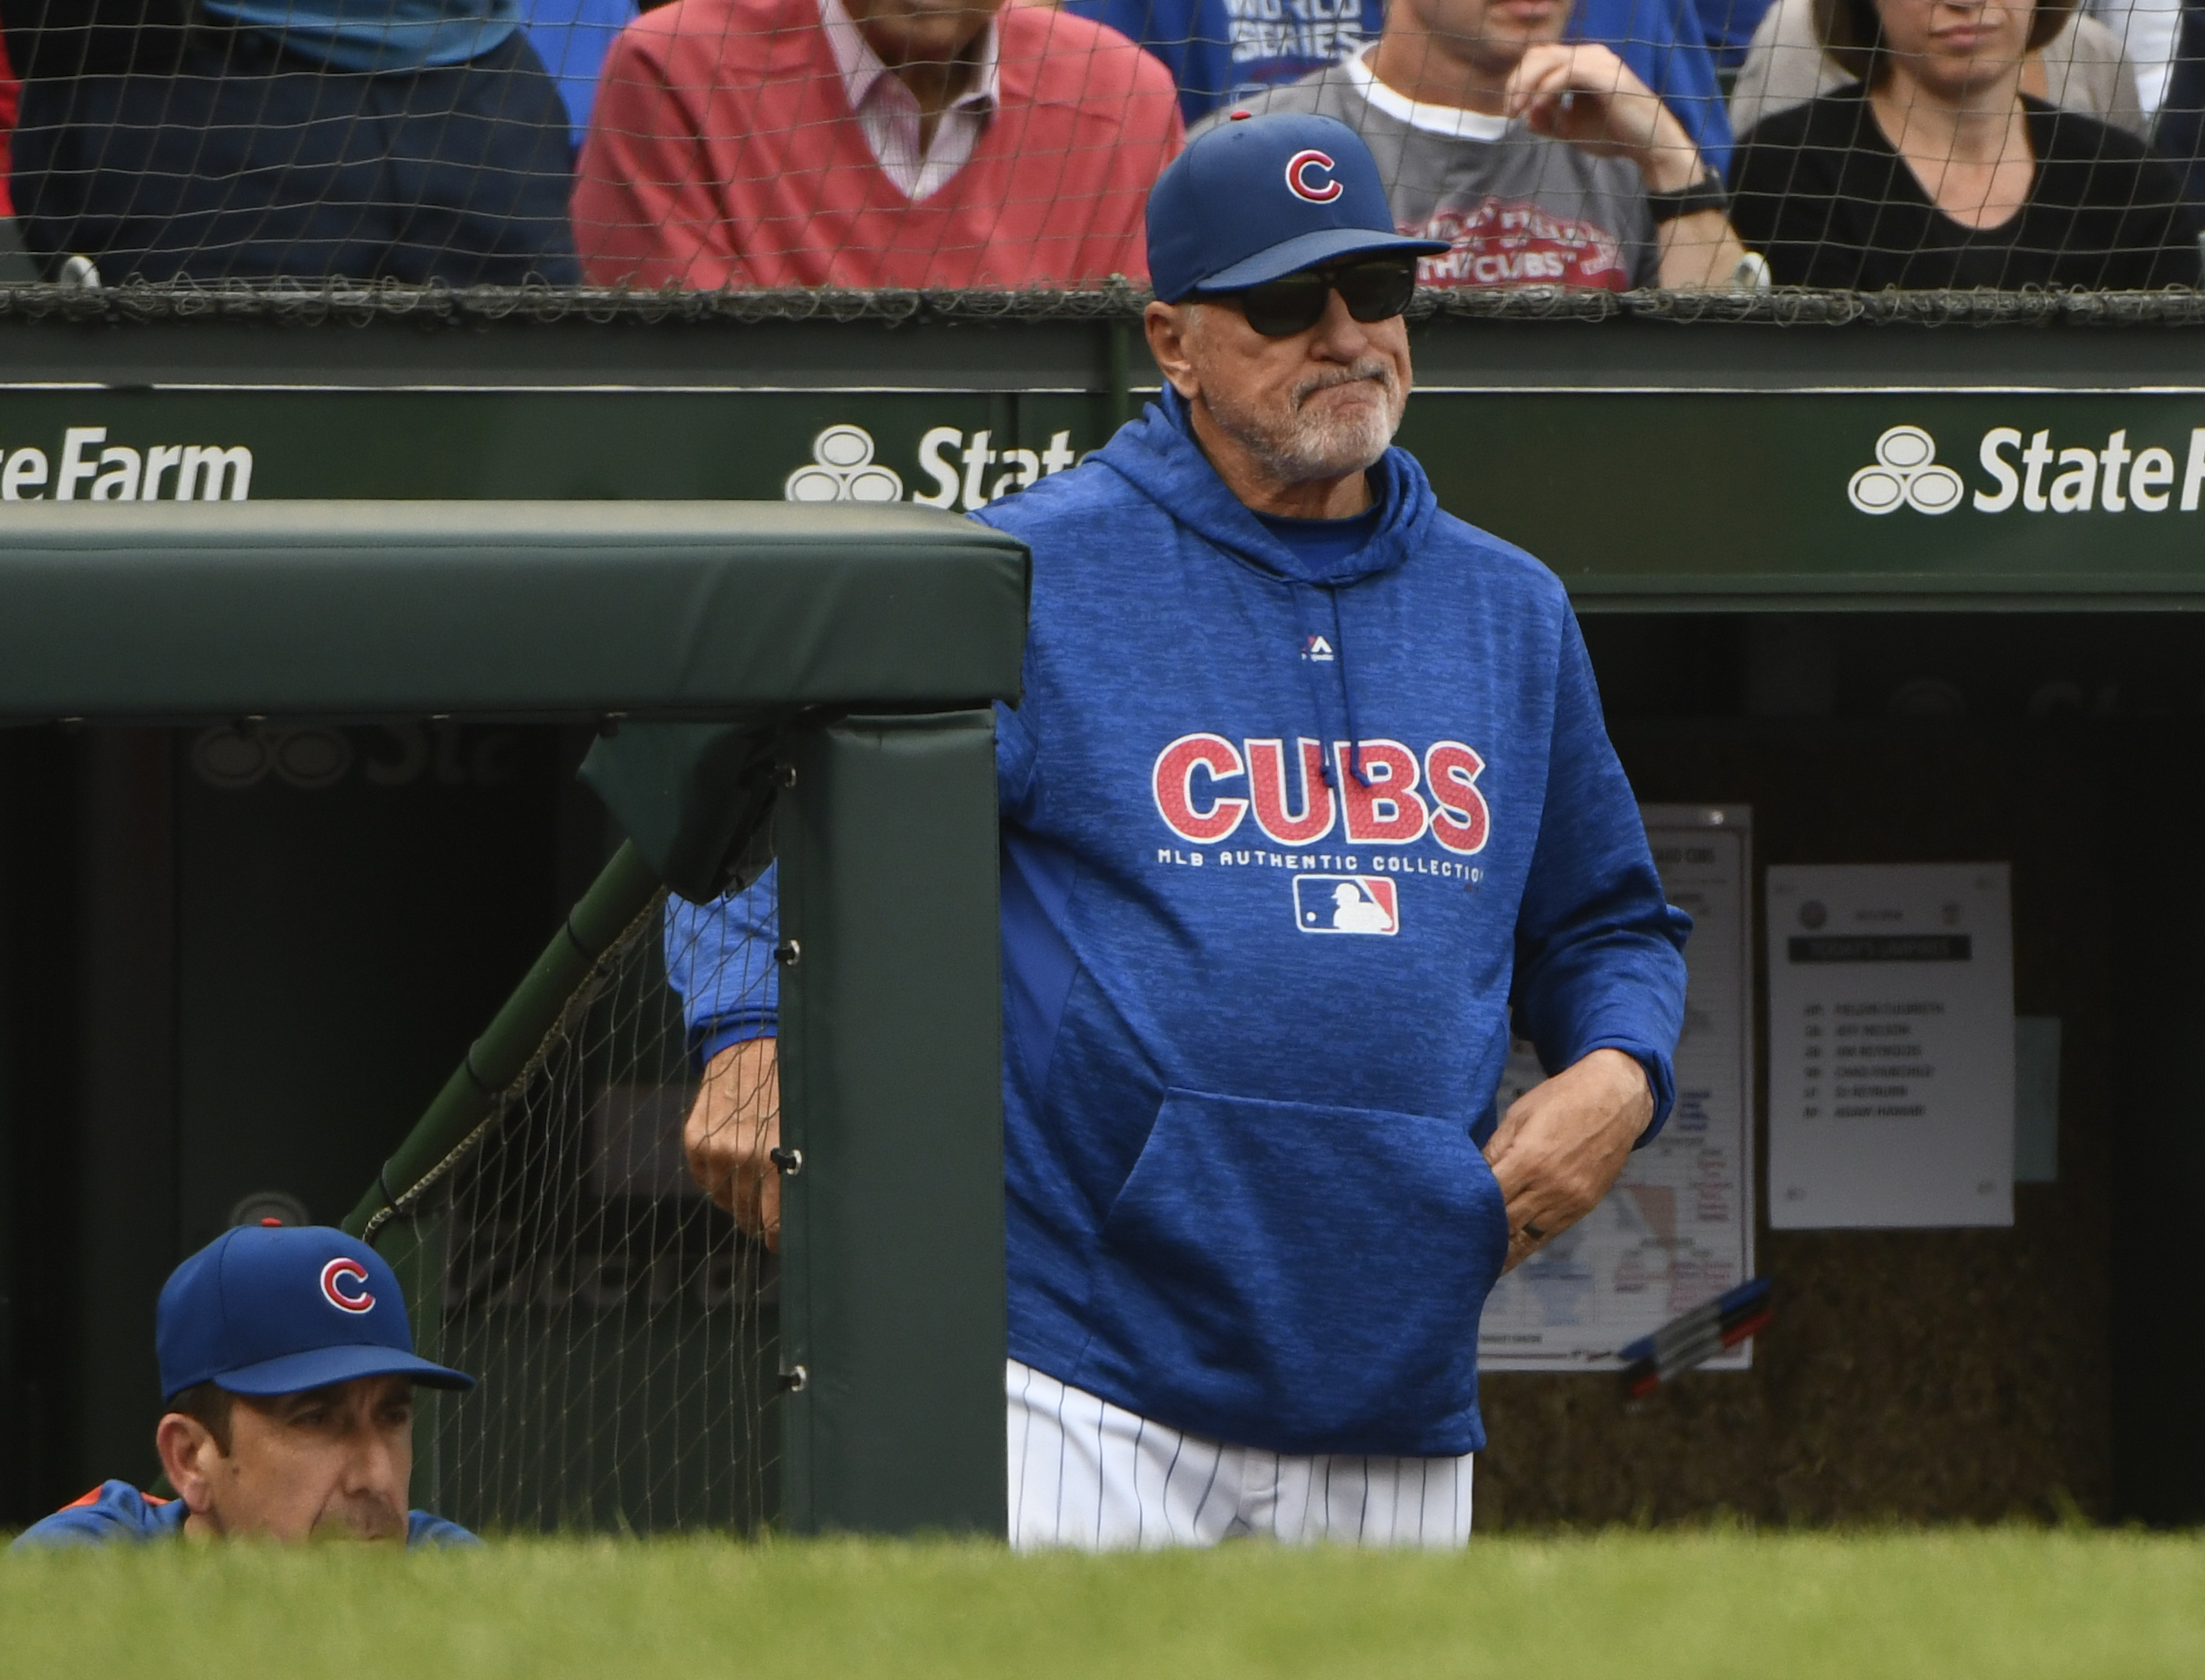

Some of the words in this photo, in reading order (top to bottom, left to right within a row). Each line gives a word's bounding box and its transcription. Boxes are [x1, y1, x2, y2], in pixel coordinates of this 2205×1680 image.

[1229, 21, 1362, 63] SERIES
[1285, 149, 1344, 204] C
[913, 426, 1092, 511] Stat
[1152, 732, 1490, 855] CUBS
[1158, 848, 1204, 866] MLB
[1219, 850, 1359, 870] AUTHENTIC
[320, 1257, 376, 1314] C
